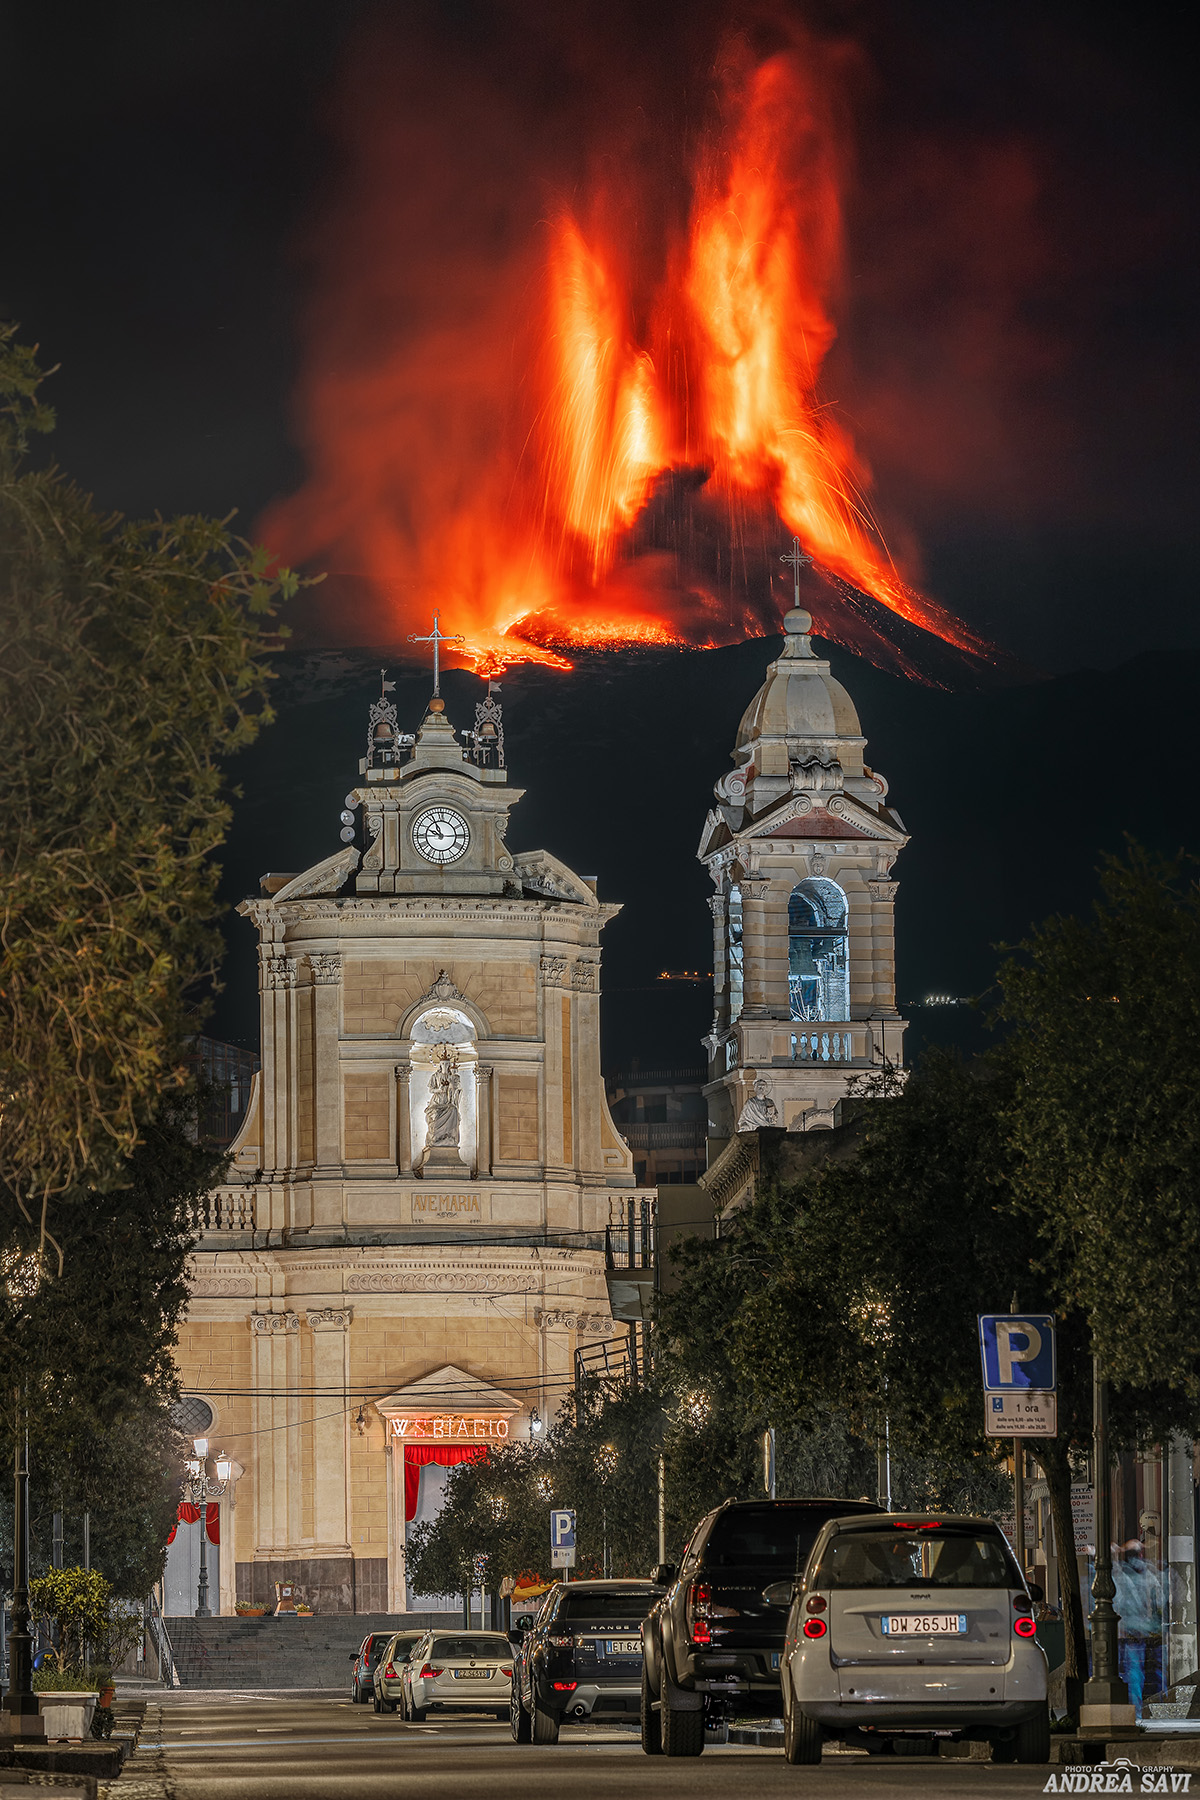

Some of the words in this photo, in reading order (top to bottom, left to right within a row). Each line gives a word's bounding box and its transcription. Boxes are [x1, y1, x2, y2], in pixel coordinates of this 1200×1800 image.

[413, 1195, 437, 1211] AVE
[439, 1195, 480, 1212] MARIA
[995, 1321, 1042, 1384] P
[1016, 1404, 1020, 1412] 1
[390, 1419, 408, 1436] W
[414, 1419, 427, 1437] S
[433, 1418, 509, 1438] BIAGIO
[556, 1513, 571, 1544] P
[891, 1618, 908, 1632] DW
[612, 1642, 624, 1651] ET
[626, 1642, 642, 1651] 64
